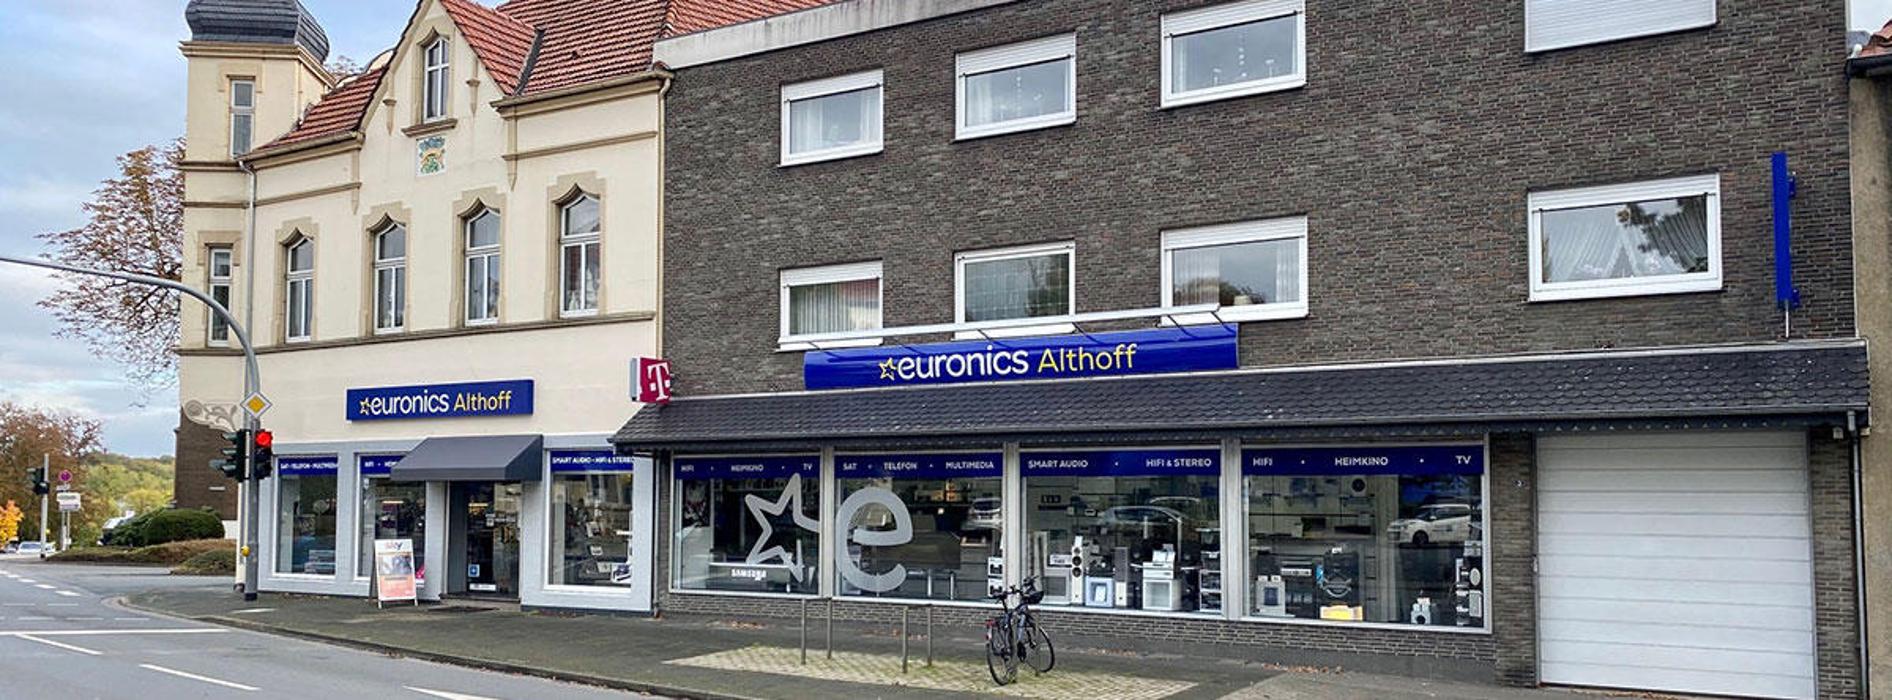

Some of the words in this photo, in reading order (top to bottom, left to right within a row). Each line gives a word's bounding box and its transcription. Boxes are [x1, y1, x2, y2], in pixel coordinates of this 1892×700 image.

[898, 345, 1029, 380] euronics
[1037, 343, 1138, 373] Althoff
[647, 361, 670, 401] T
[371, 389, 450, 415] euronics
[453, 391, 512, 411] Althoff
[572, 456, 591, 464] AUDIO
[843, 462, 857, 471] SAT
[883, 462, 918, 471] TELEFON
[945, 460, 994, 470] MULTIMEDIA
[1028, 459, 1058, 469] SMART
[1059, 459, 1088, 468] AUDIO
[1145, 458, 1165, 468] HIFI
[1166, 458, 1172, 467] &
[1173, 457, 1212, 467] STEREO
[1252, 456, 1273, 467] HIFI
[1334, 456, 1389, 467] HEIMKINO
[1455, 454, 1471, 465] TV
[730, 464, 764, 472] HEIMKINO
[803, 463, 813, 471] TV
